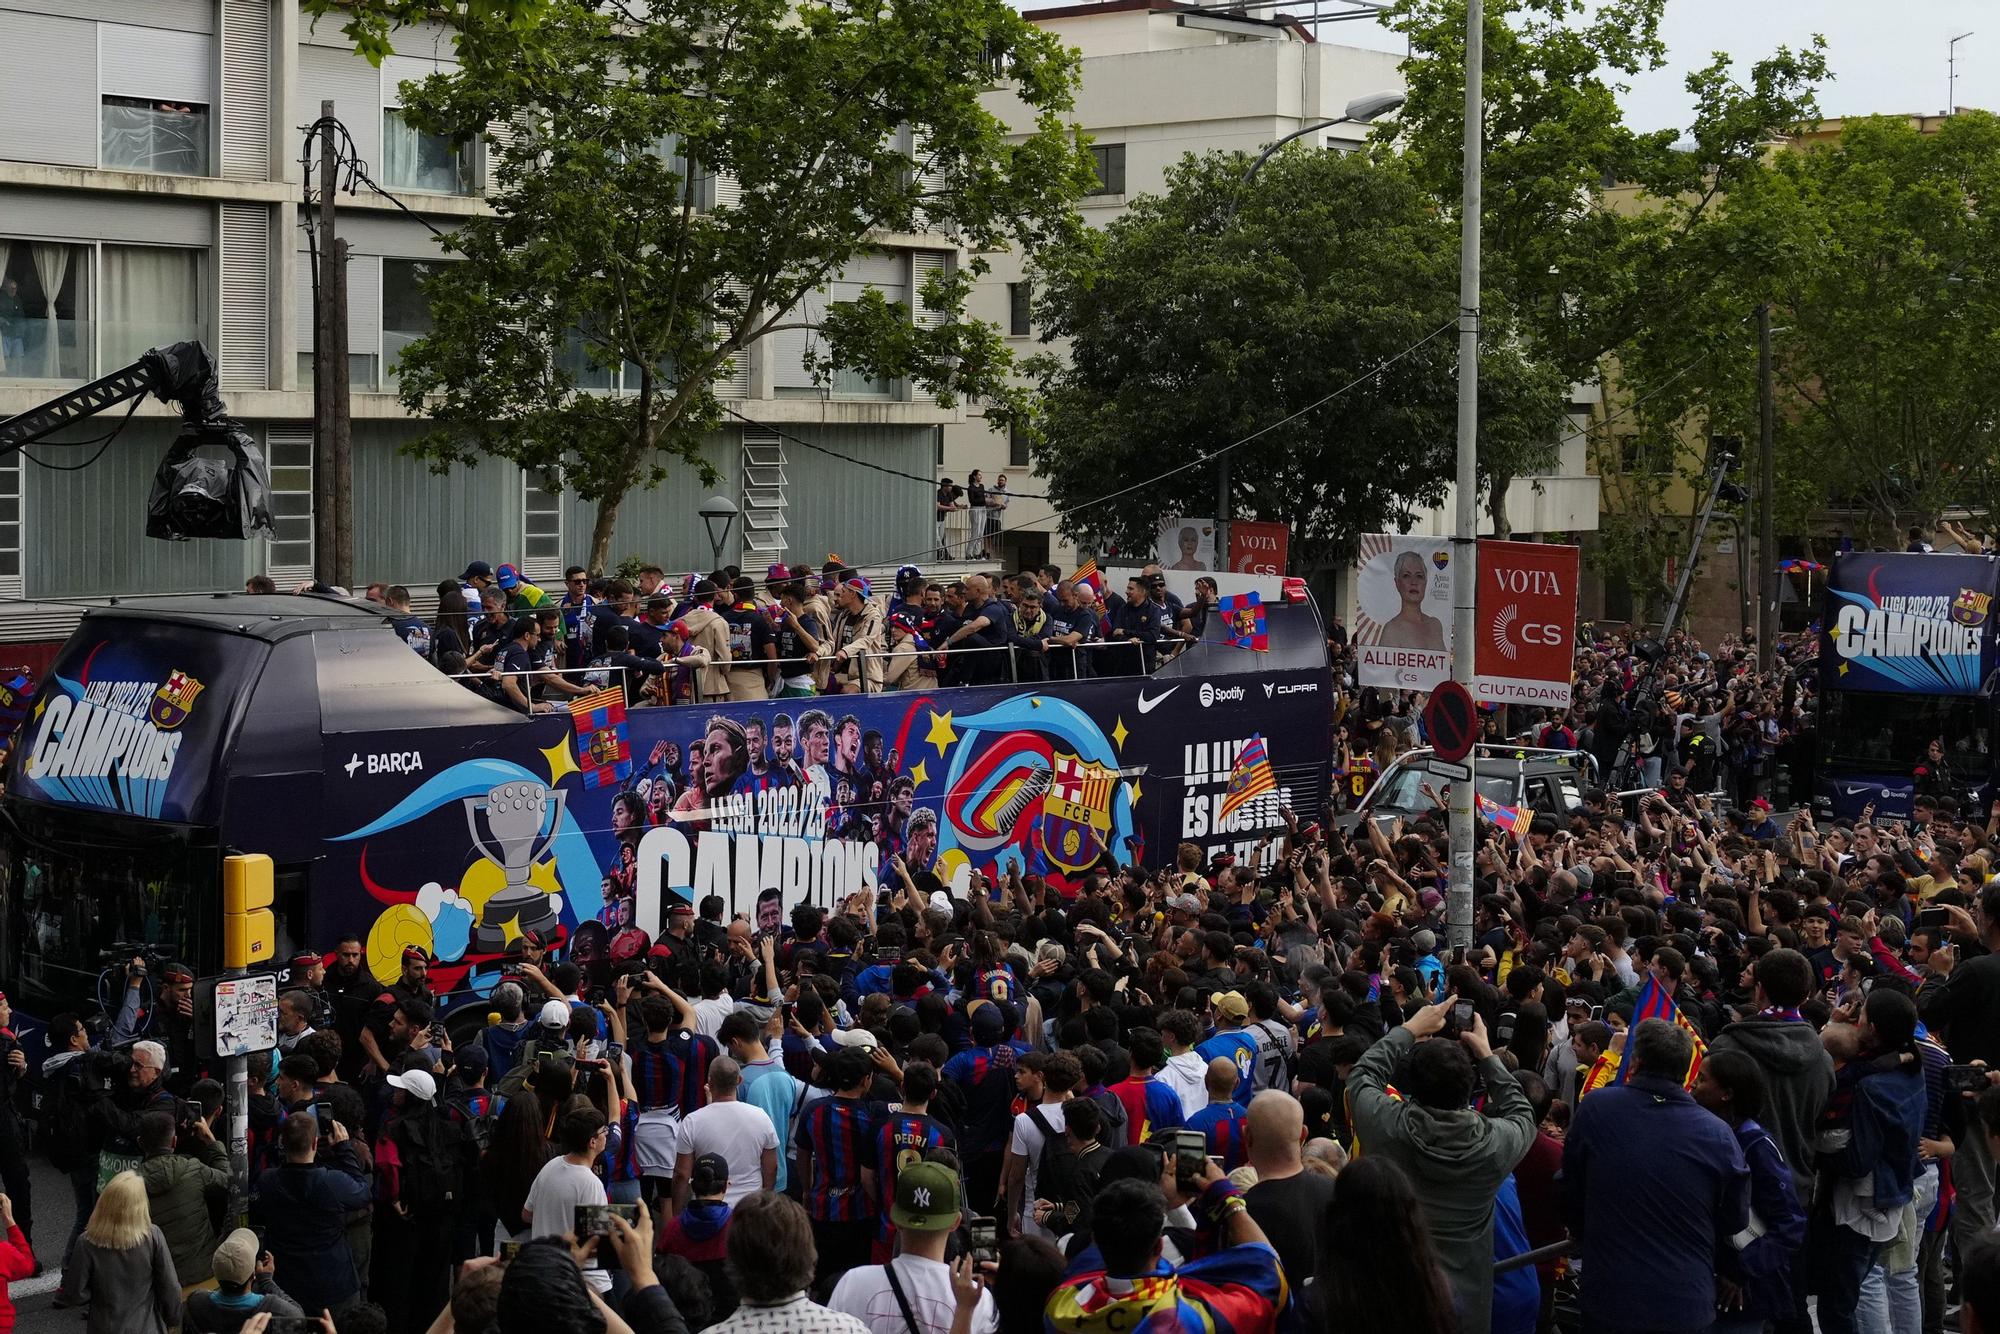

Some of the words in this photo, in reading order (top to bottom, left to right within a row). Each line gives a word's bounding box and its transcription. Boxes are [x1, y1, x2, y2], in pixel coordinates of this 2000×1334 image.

[1240, 536, 1277, 550] VOTA
[1494, 568, 1561, 596] VOTA
[1907, 596, 1950, 620] 2022/23
[1521, 623, 1562, 646] CS
[1836, 604, 1983, 659] CAMPIONES
[1364, 650, 1446, 670] ALLIBERA'T
[166, 693, 183, 706] FCB
[1215, 686, 1245, 702] Spotify
[1278, 683, 1318, 694] CUPRA
[1478, 683, 1568, 701] CIUTADANS
[28, 694, 183, 781] CAMPIONS
[367, 751, 423, 775] BARÇA
[1184, 742, 1209, 786] LA
[1352, 775, 1365, 797] 8
[757, 782, 827, 839] 2022/23
[1063, 803, 1091, 822] FCB
[1182, 786, 1209, 839] ÉS
[1264, 1056, 1281, 1089] 7
[894, 1133, 927, 1148] PEDRI
[913, 1186, 931, 1208] NY
